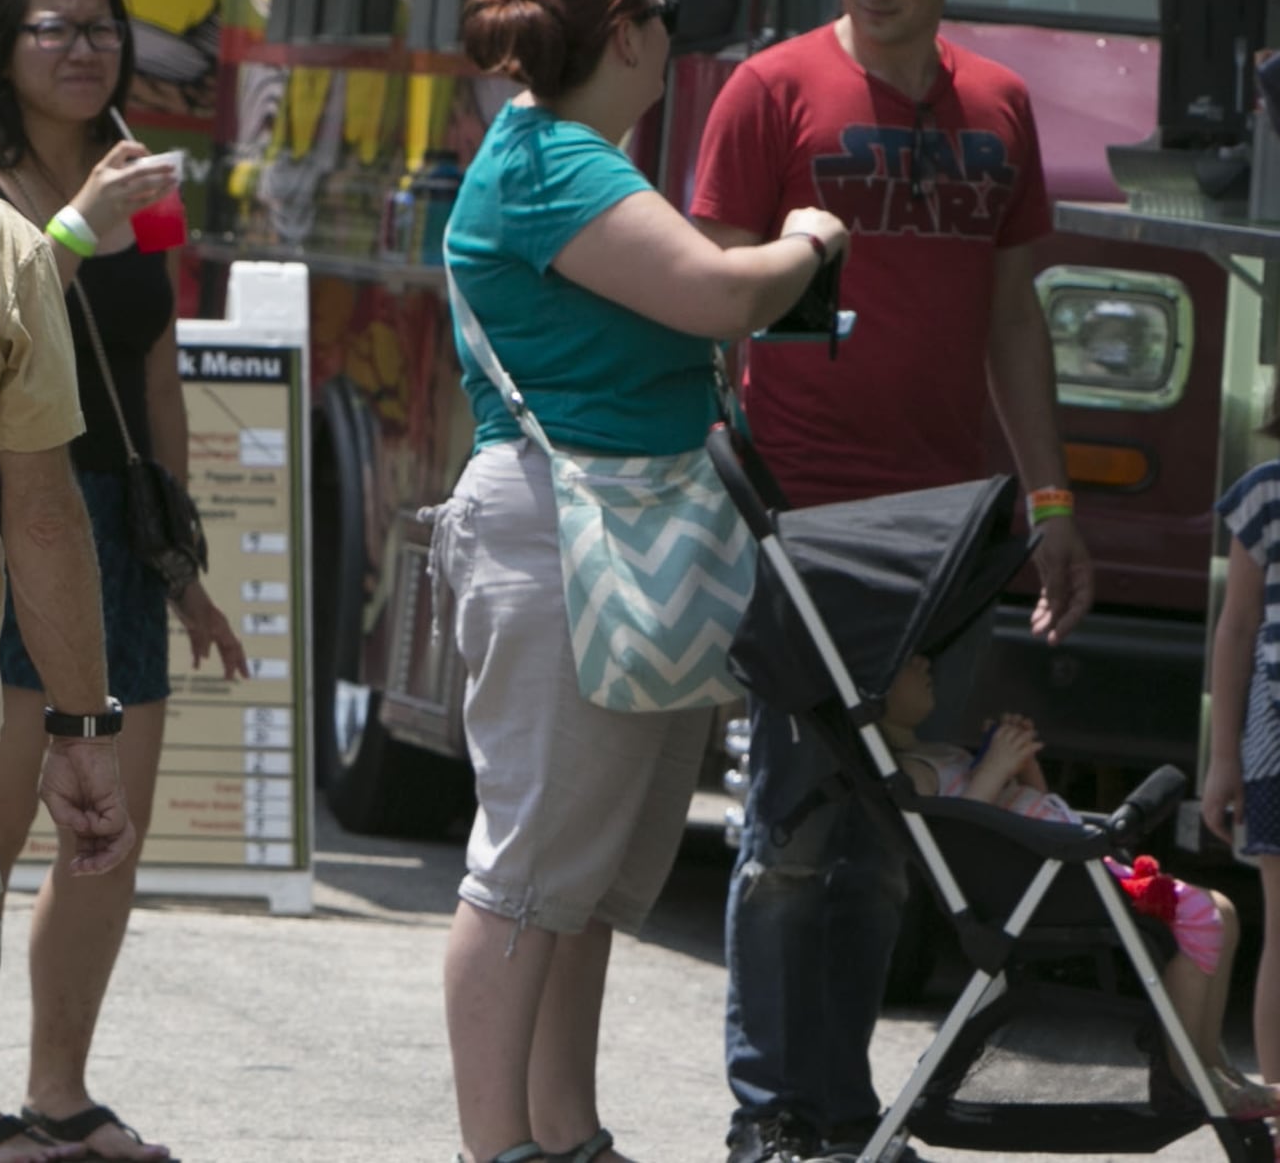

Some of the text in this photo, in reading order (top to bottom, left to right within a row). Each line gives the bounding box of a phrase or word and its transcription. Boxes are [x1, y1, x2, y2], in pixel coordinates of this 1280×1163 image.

[812, 123, 1017, 186] STAR
[813, 176, 1018, 242] WARS
[201, 351, 282, 378] Menu
